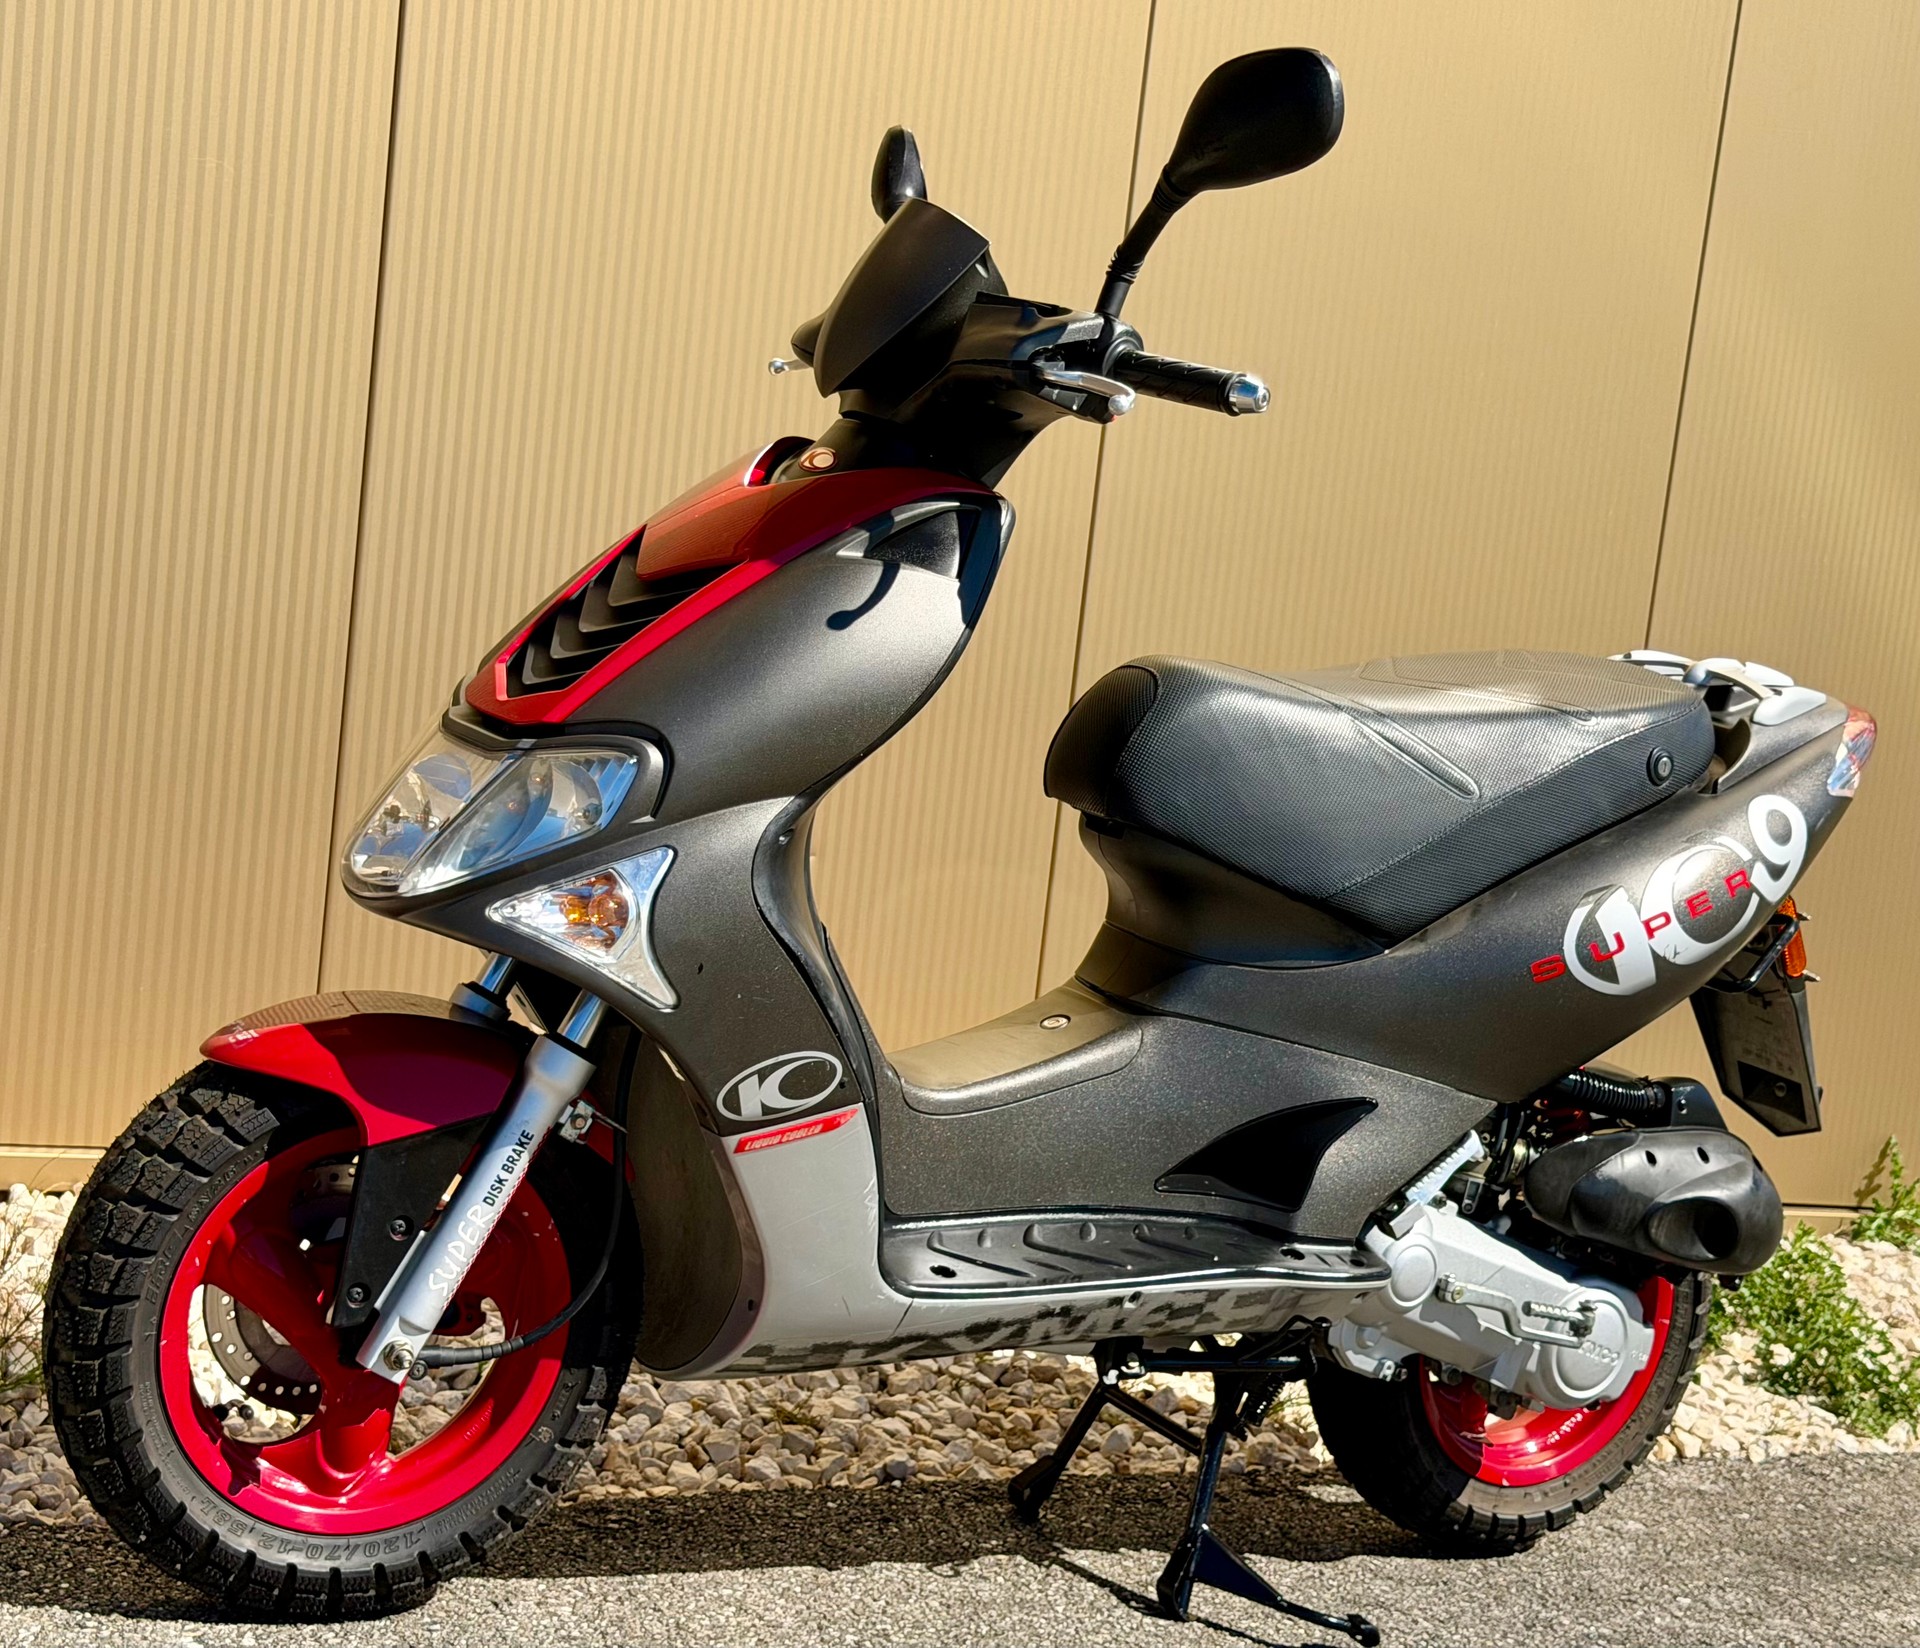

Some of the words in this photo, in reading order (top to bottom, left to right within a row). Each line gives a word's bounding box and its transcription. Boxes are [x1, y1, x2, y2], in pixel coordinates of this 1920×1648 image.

[1529, 869, 1752, 984] SUPER
[745, 1133, 782, 1151] LIQUID
[782, 1124, 824, 1144] COOLED
[429, 1204, 494, 1296] SUPER
[482, 1173, 509, 1207] DISK
[501, 1129, 535, 1174] BRAKE
[256, 1530, 422, 1561] 120/70-12
